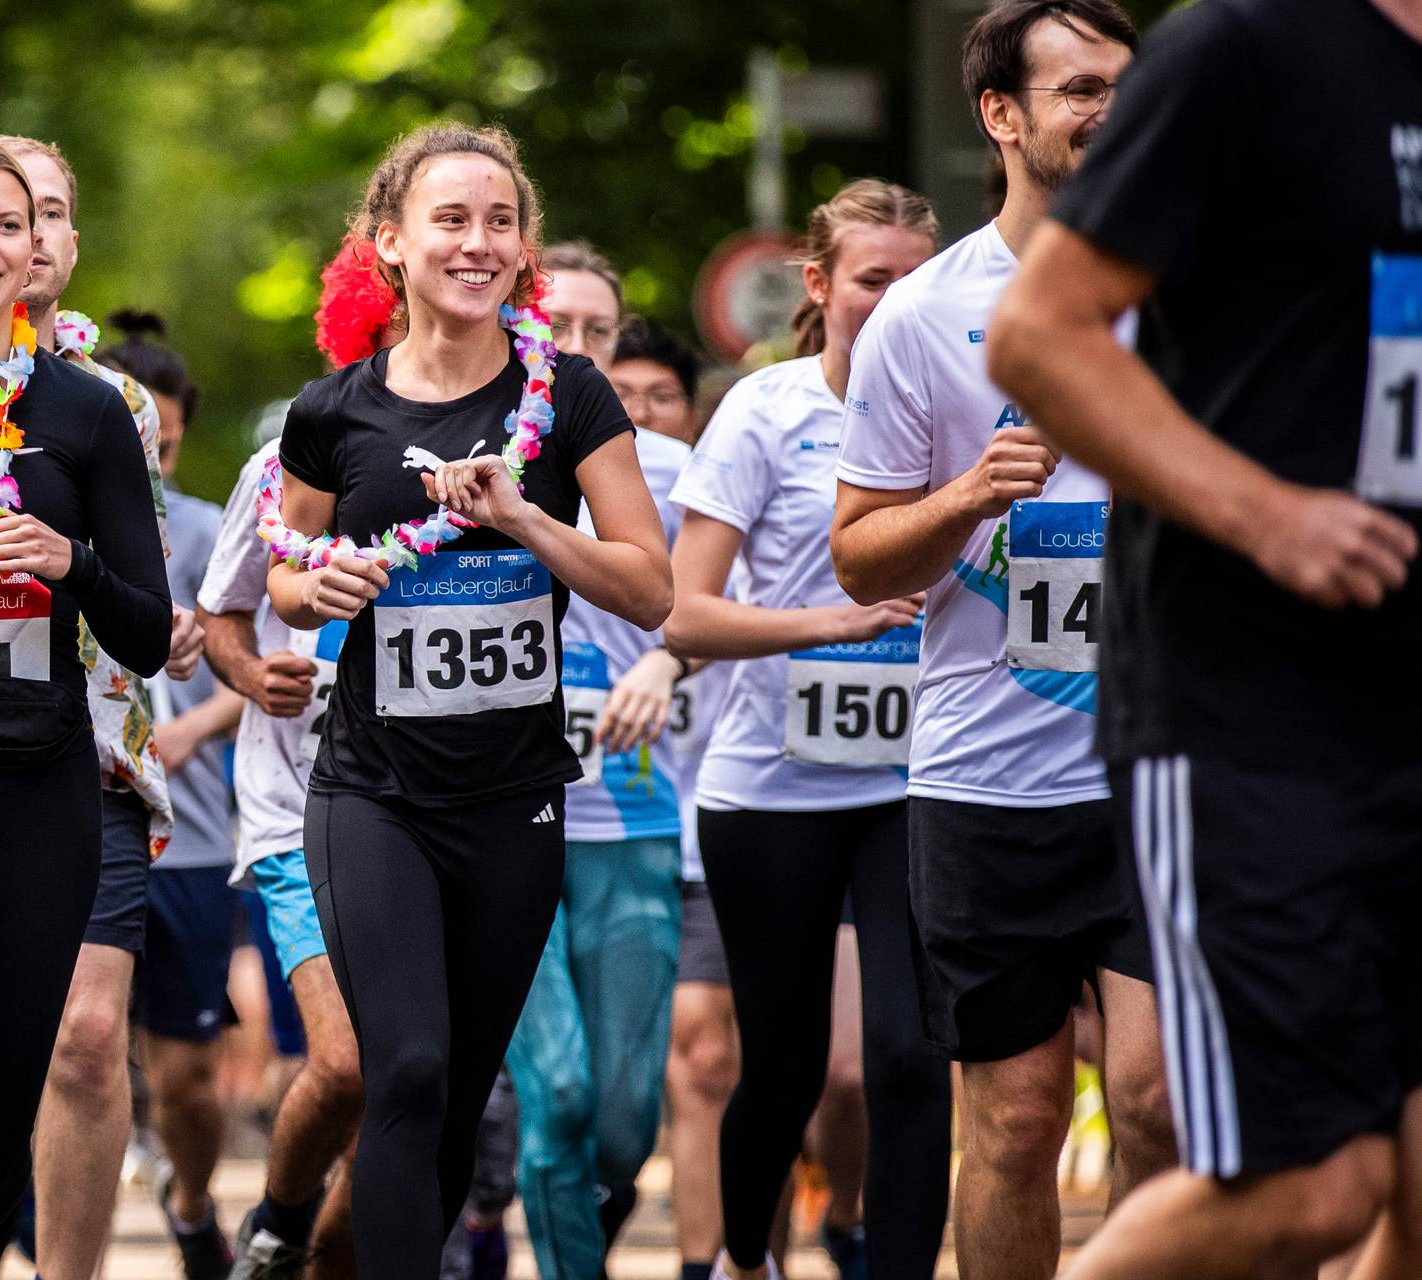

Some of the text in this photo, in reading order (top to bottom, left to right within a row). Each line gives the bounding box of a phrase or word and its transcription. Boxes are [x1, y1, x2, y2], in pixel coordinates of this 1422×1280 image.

[458, 555, 492, 568] SPORT
[400, 572, 535, 599] Lousberglauf
[386, 619, 548, 690] 1353
[797, 682, 915, 740] 150
